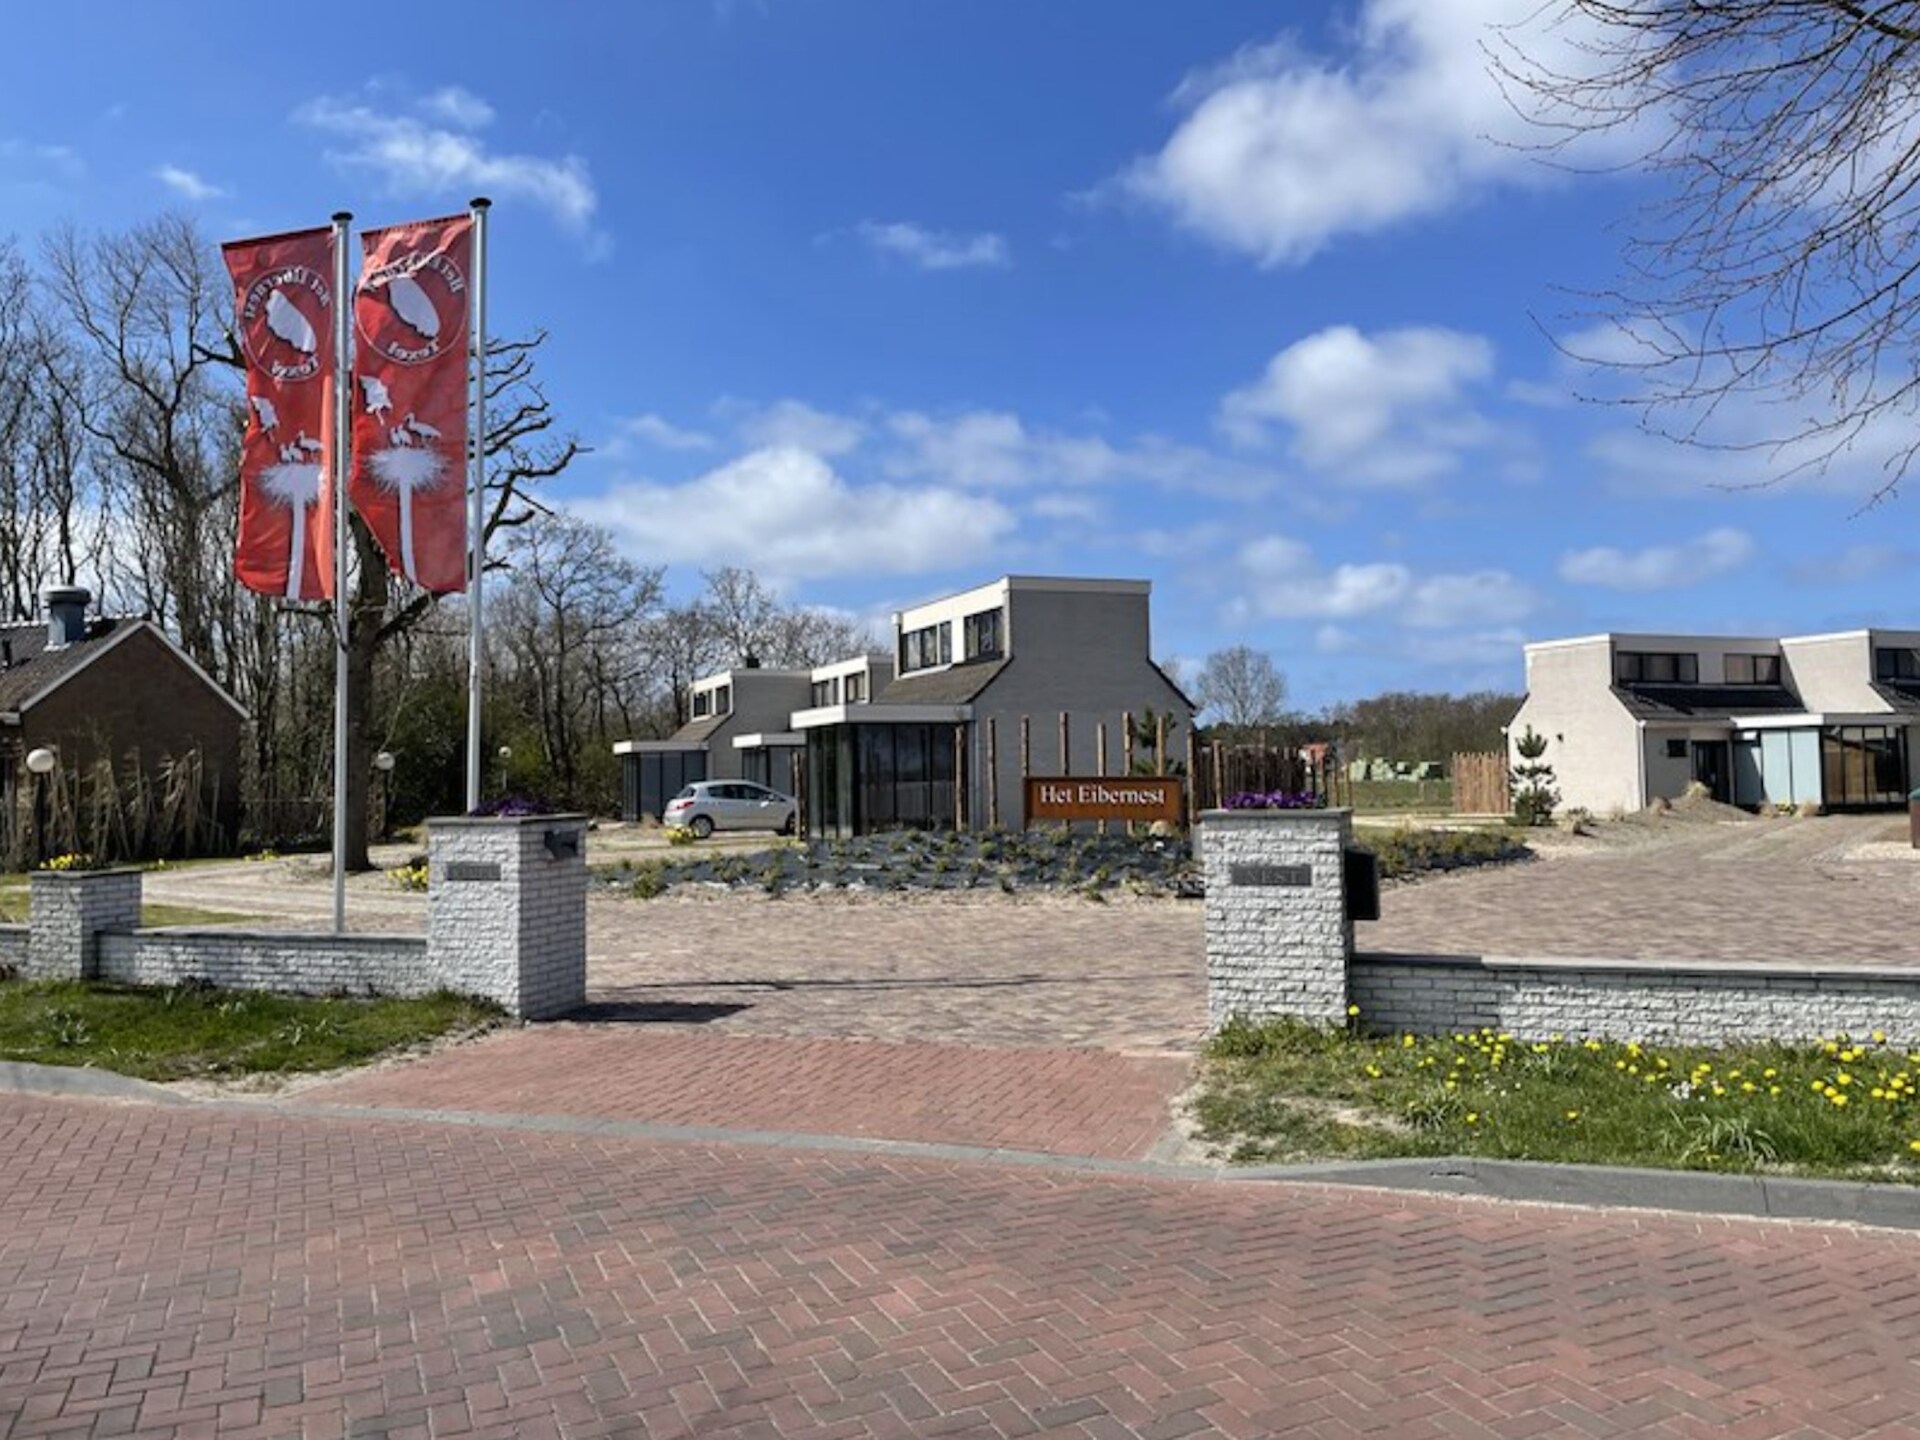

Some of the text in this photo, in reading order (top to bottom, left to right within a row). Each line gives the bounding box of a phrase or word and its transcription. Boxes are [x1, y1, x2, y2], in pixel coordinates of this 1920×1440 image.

[1040, 784, 1165, 804] Het Eibernest
[1246, 869, 1301, 884] NEST
